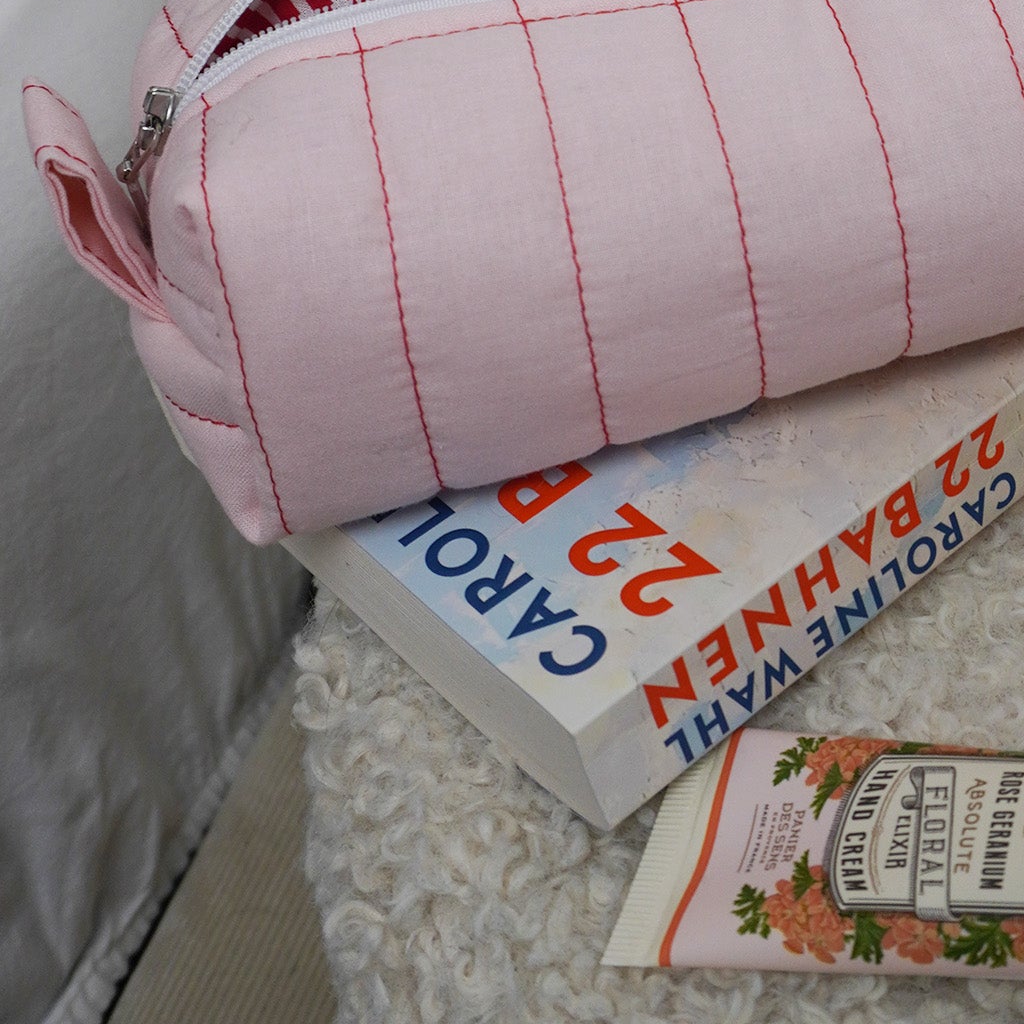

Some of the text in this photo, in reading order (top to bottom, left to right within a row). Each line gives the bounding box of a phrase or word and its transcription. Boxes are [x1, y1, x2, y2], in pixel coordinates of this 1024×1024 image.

[367, 496, 607, 676] CAROL
[568, 502, 722, 618] 22
[642, 412, 1005, 730] 22 BAHNEN
[664, 472, 1016, 764] CAROLINE WAHL
[746, 842, 760, 872] FRANCE
[760, 804, 769, 827] MADE
[764, 802, 794, 871] DES SENS
[780, 810, 806, 863] PANIER
[840, 769, 898, 892] HAND CREAM
[884, 814, 912, 869] ELIXIR
[918, 786, 949, 896] FLORAL
[954, 778, 988, 874] ABSOLUTE
[979, 771, 1024, 890] ROSE GERANIUM
